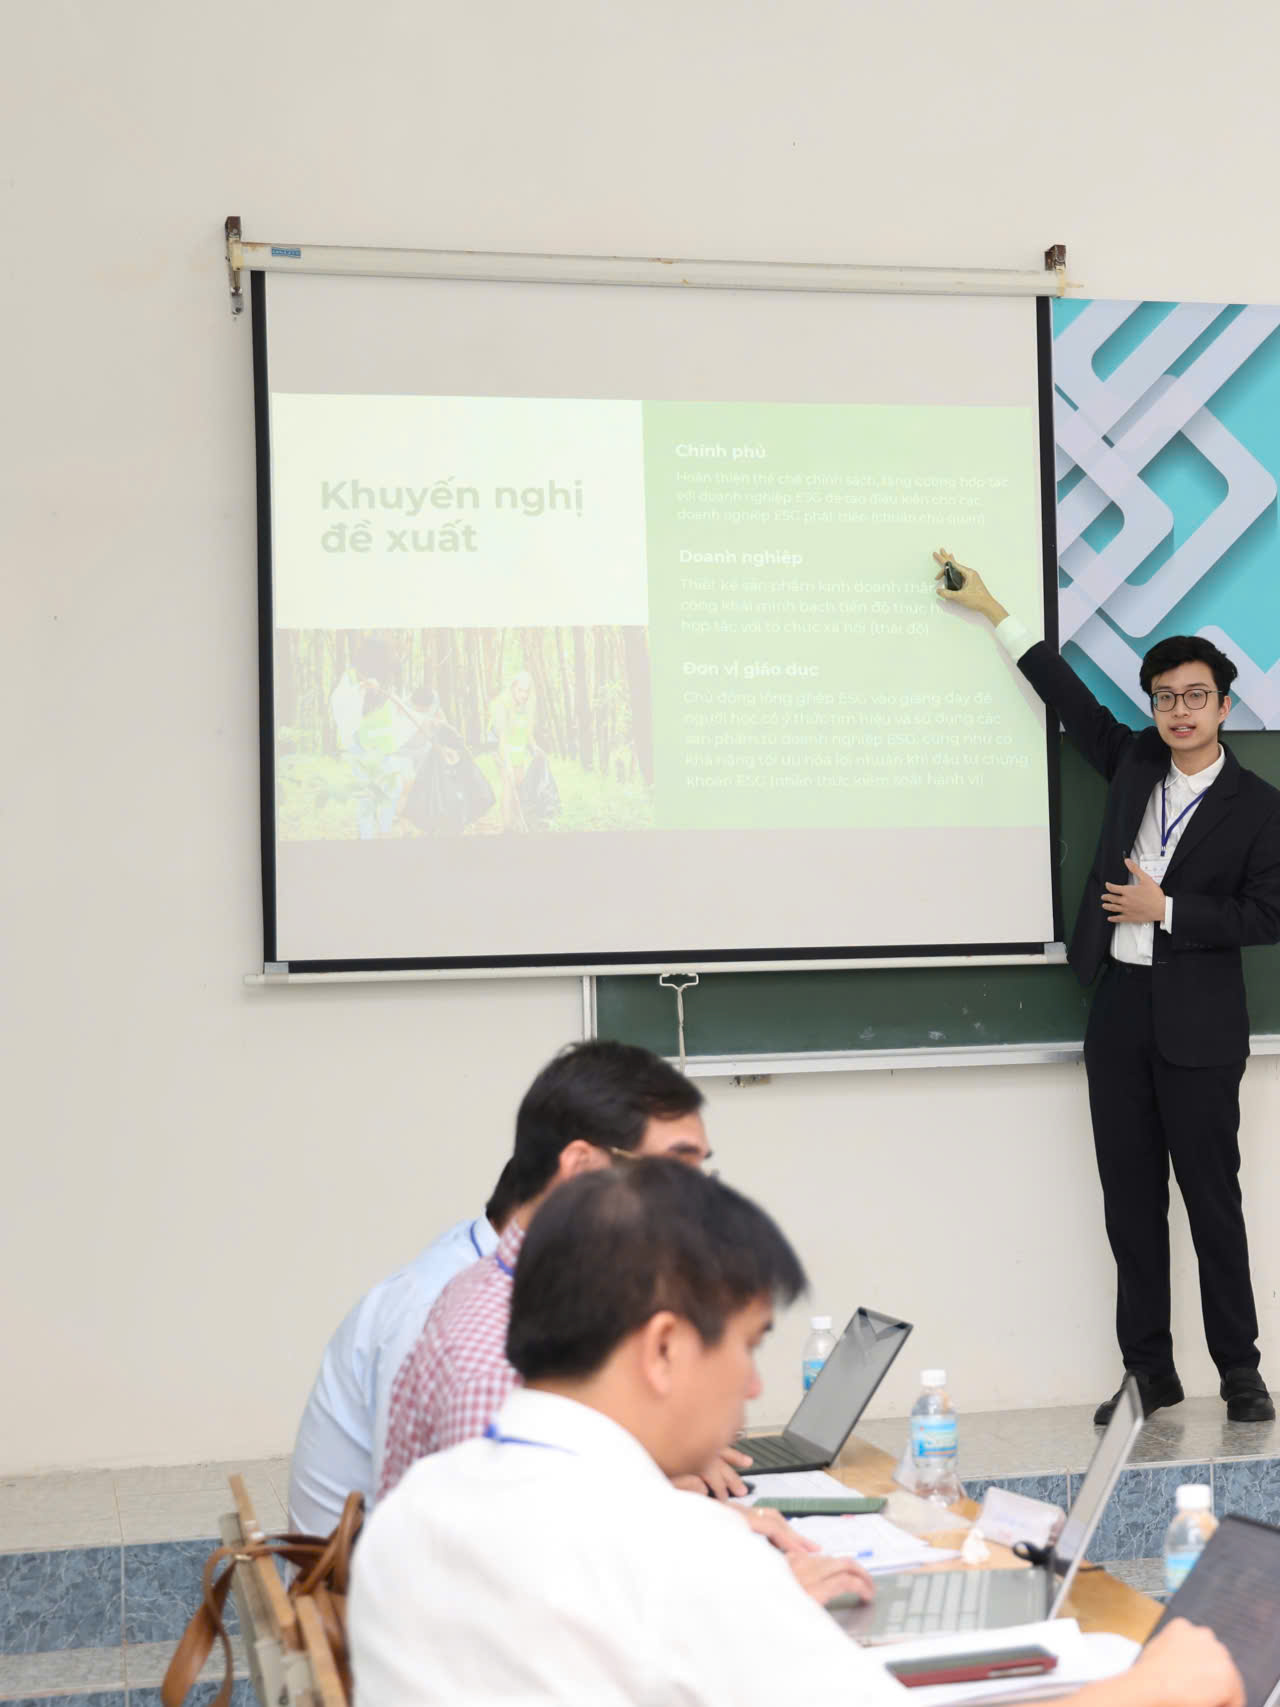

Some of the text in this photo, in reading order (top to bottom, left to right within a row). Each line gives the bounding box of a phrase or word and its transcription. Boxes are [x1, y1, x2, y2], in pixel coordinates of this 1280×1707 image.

[675, 442, 767, 462] Chính phủ
[321, 476, 584, 517] Khuyến nghị
[321, 519, 478, 553] đề xuất
[679, 549, 803, 568] Doanh nghiệp
[682, 660, 820, 680] Đơn vị giáo dục
